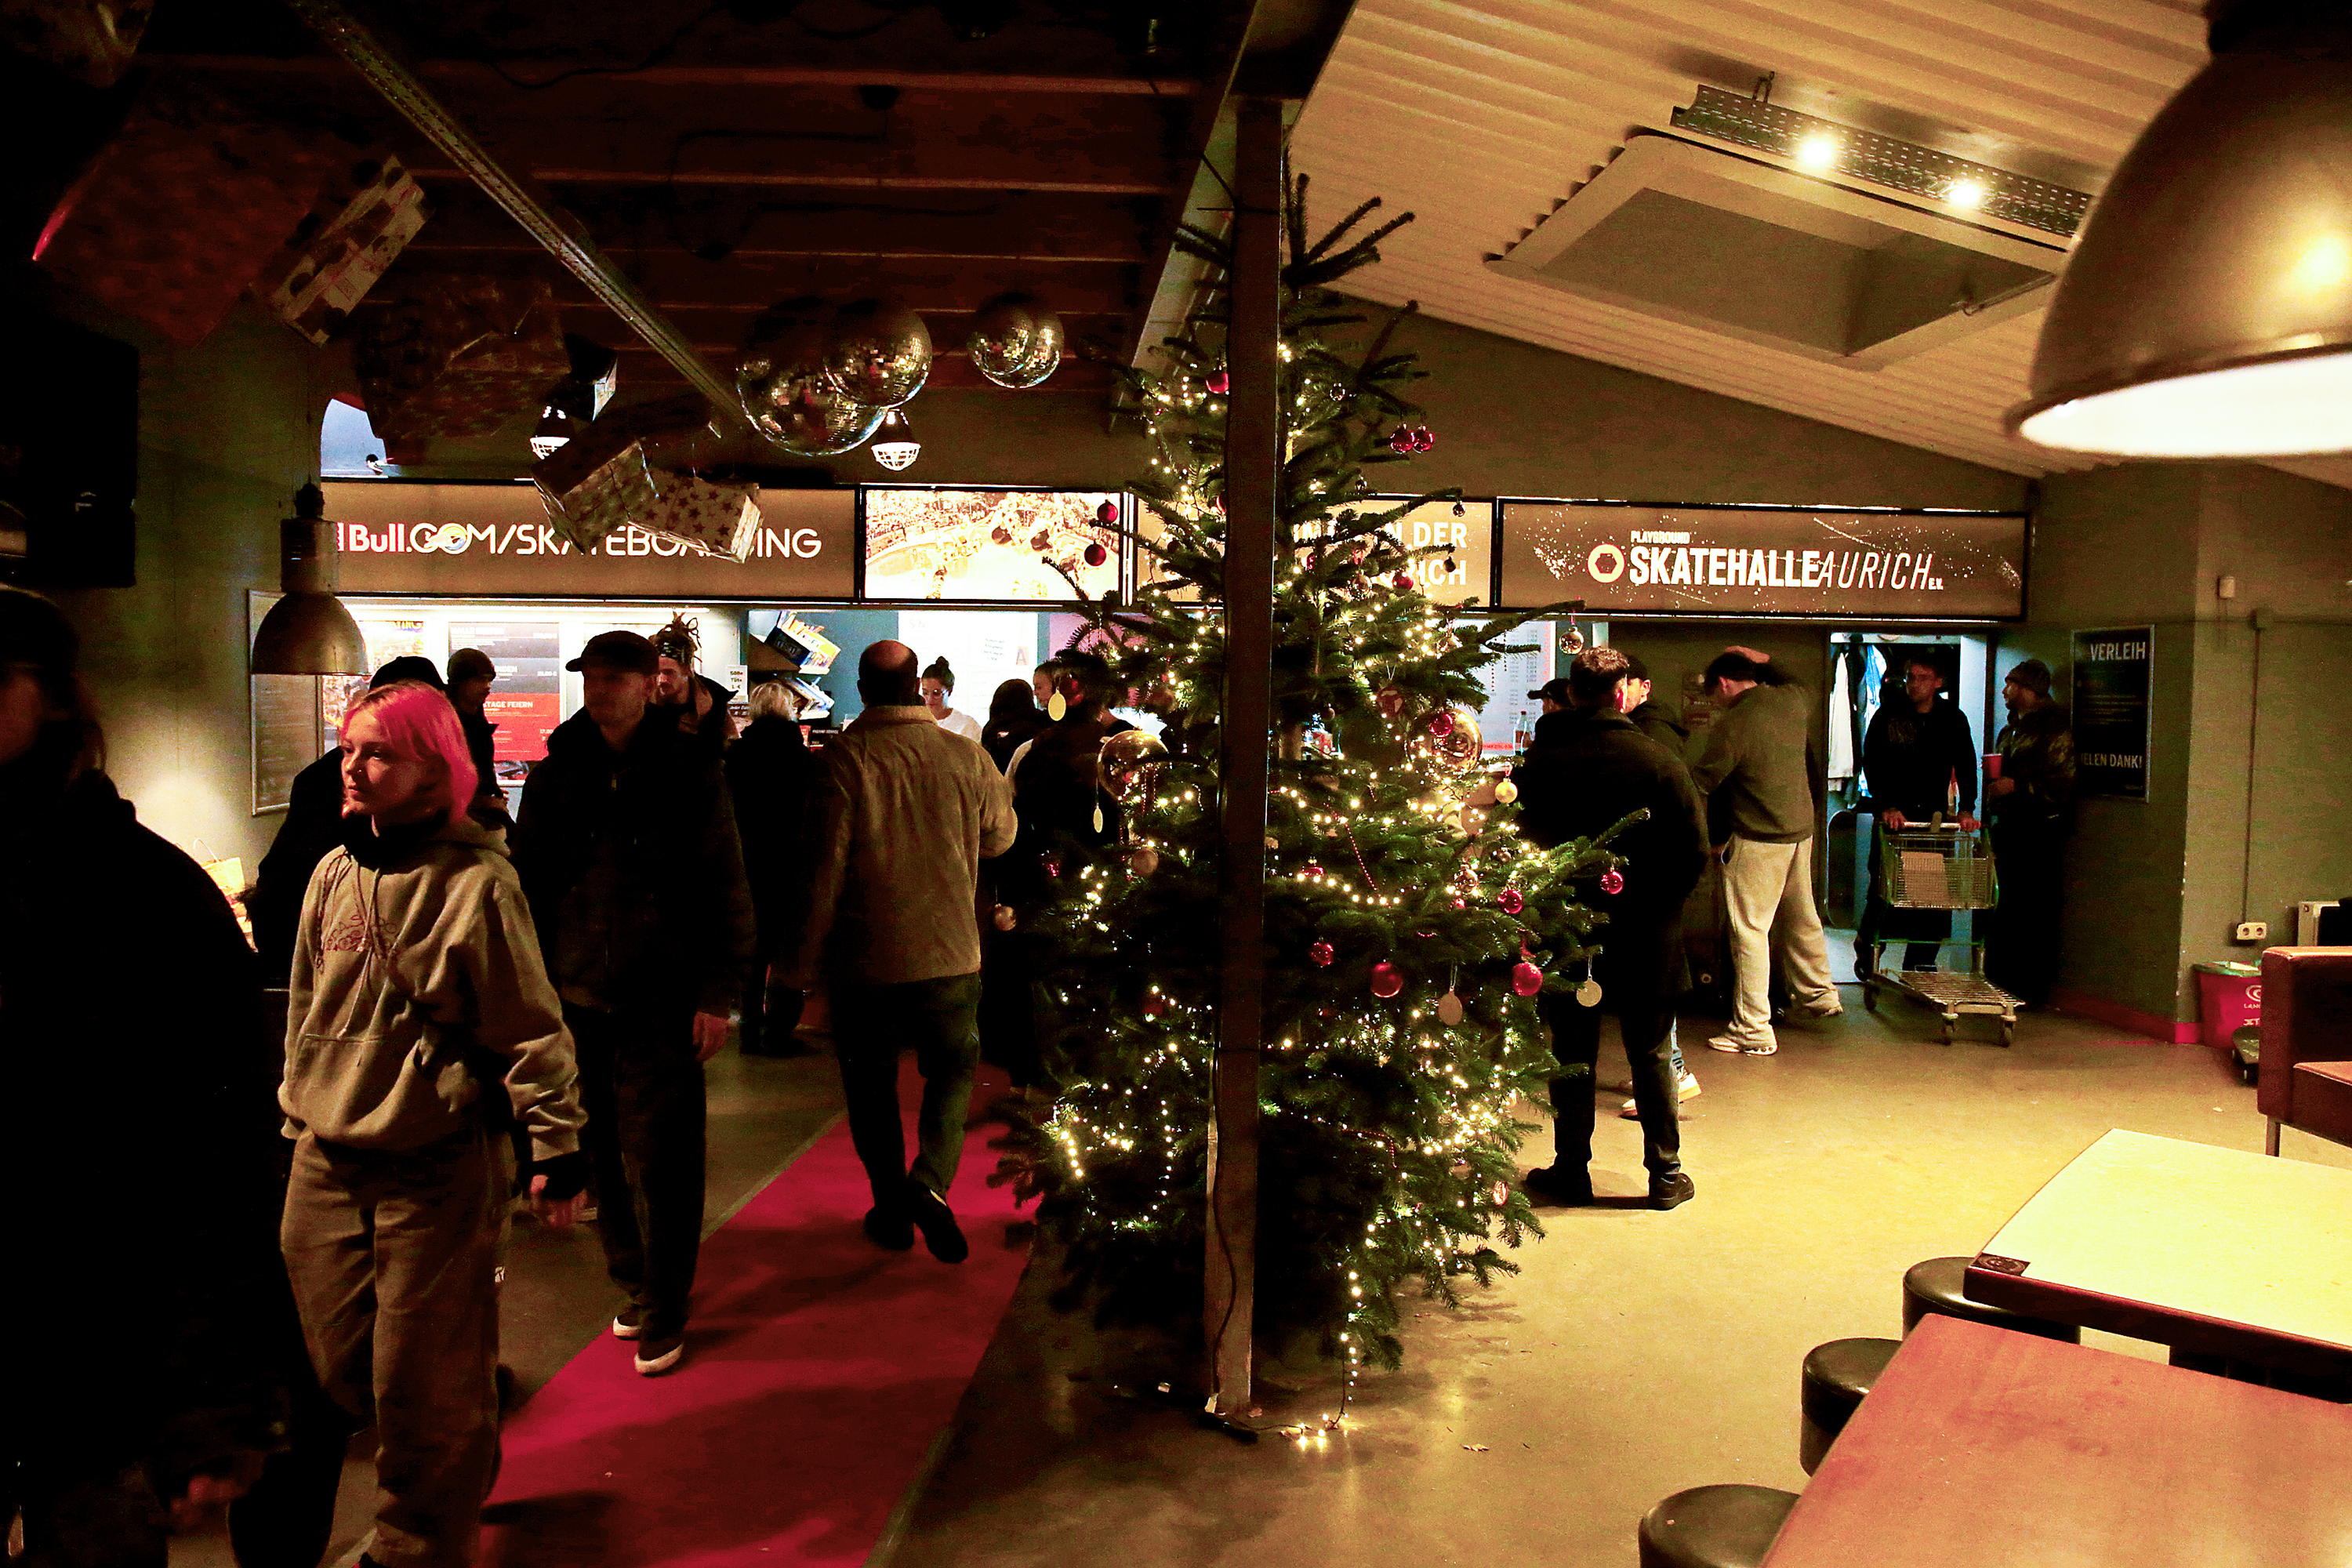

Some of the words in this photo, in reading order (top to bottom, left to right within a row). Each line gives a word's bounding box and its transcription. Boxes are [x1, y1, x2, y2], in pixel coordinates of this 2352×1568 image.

[1414, 521, 1468, 547] DER
[1631, 530, 1690, 544] PLAYGROUND
[2090, 642, 2146, 662] VERLEIH
[2109, 753, 2143, 769] DANK!
